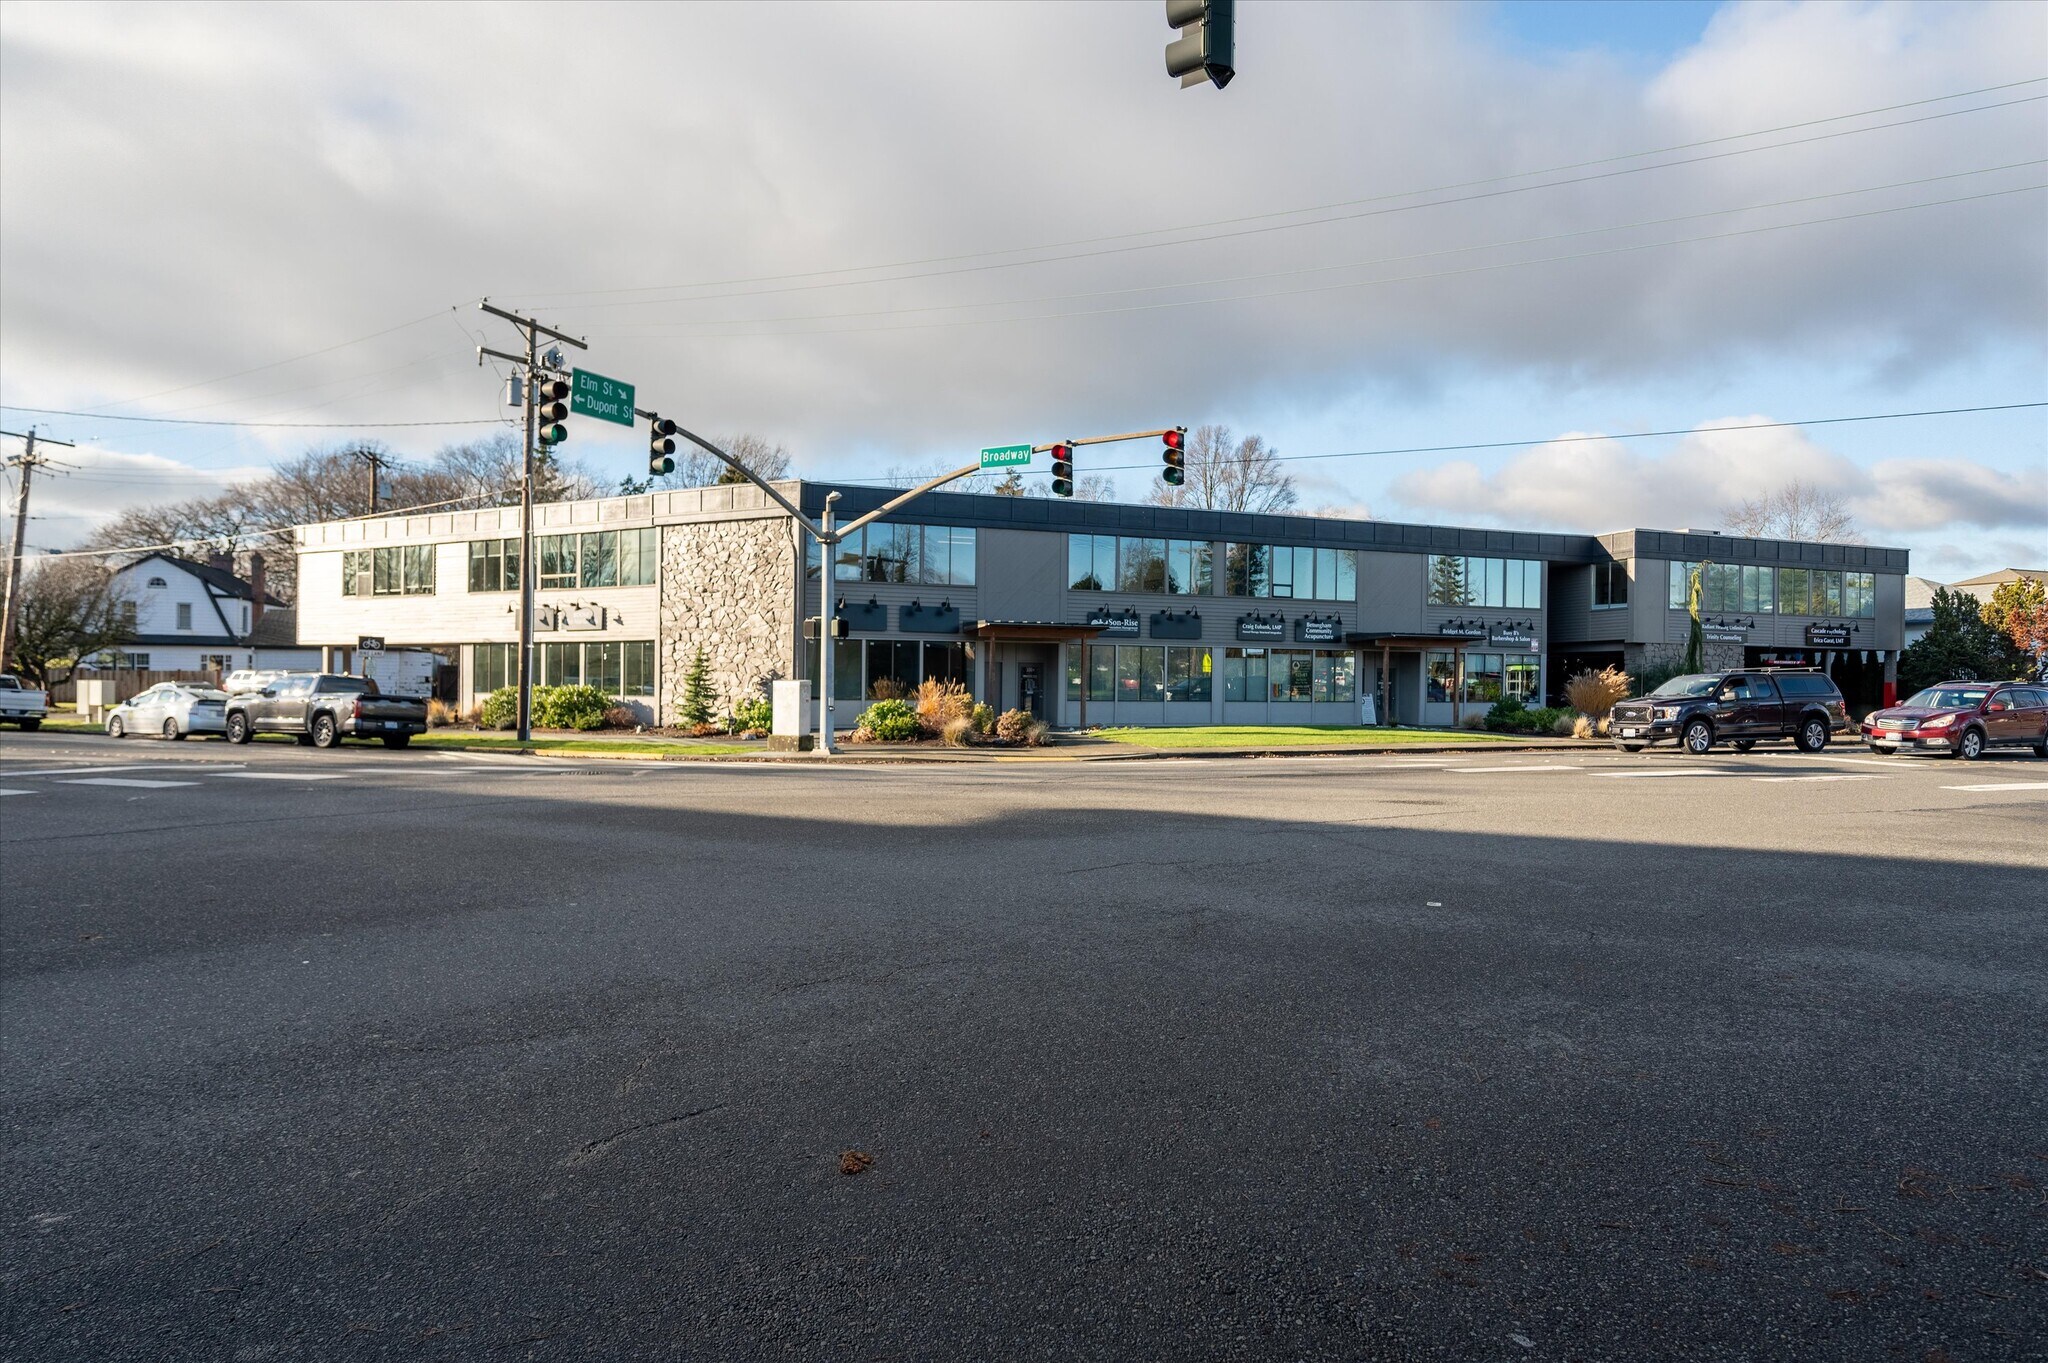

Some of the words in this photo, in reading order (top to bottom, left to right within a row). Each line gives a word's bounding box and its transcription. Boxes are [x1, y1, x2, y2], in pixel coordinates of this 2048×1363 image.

[580, 374, 598, 392] Elm
[602, 382, 613, 396] St
[587, 395, 618, 416] Dupont
[622, 405, 632, 420] St
[982, 450, 1029, 462] Broadway
